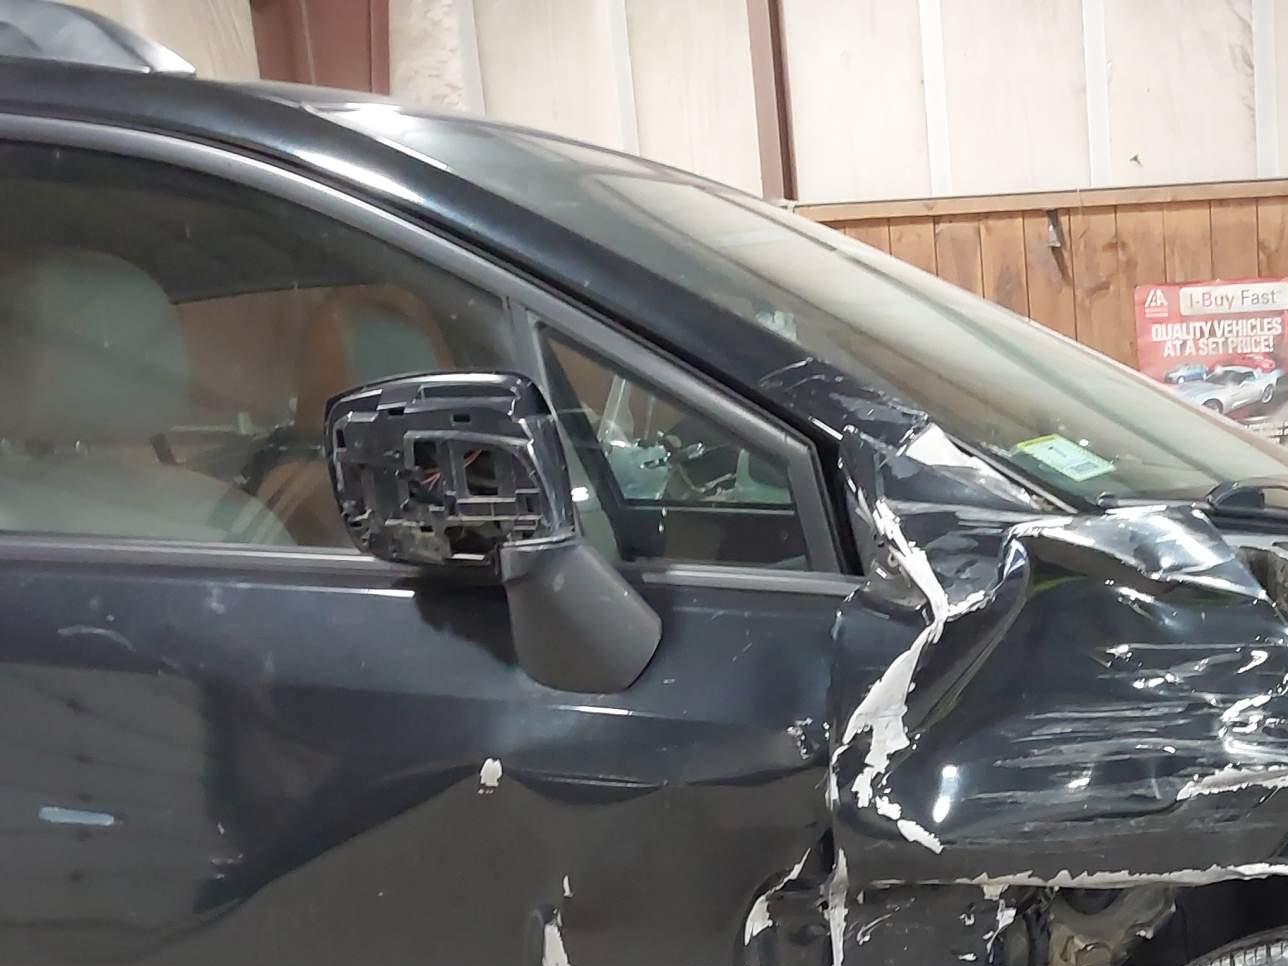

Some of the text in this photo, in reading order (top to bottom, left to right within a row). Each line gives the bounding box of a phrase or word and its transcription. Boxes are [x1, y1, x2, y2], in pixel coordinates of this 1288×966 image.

[1189, 289, 1277, 310] I-Buy Fast
[1152, 317, 1282, 342] QUALITY VEHICLES
[1163, 336, 1274, 358] AT A SET PRICE!
